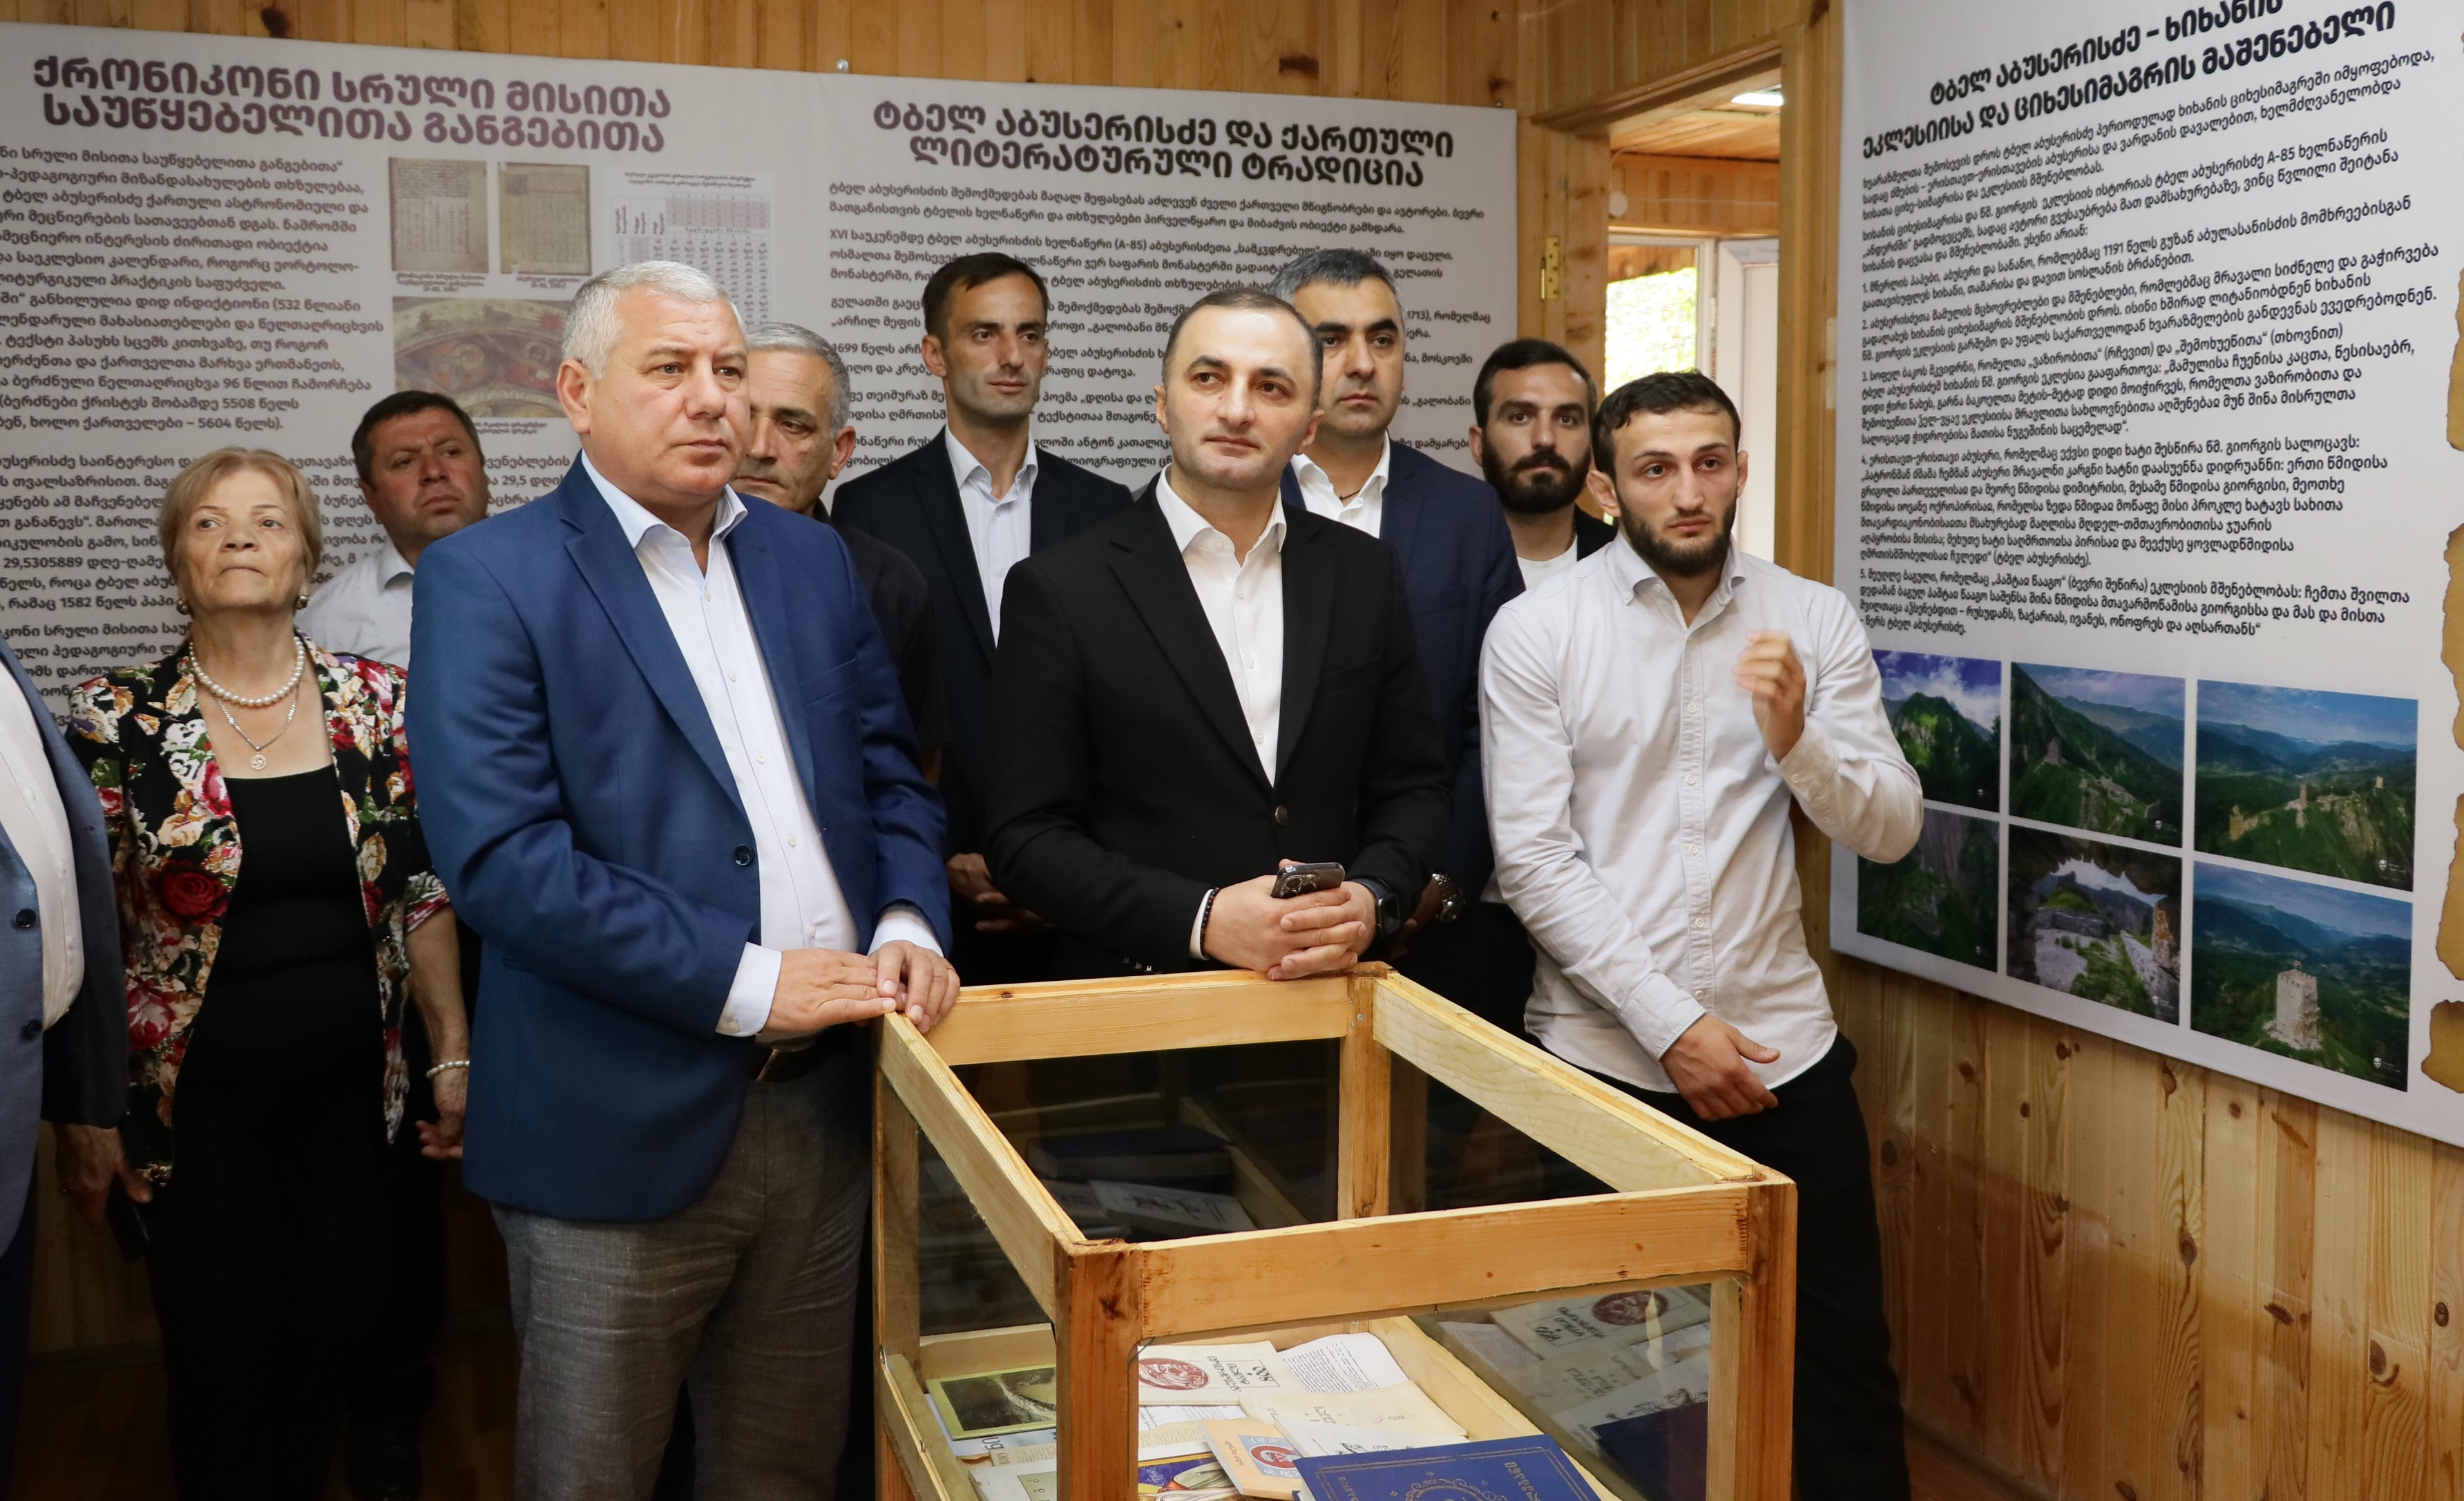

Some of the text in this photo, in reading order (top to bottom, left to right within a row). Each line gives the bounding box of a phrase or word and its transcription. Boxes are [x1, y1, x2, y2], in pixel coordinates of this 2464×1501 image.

[33, 55, 671, 119] ქრონიკონი სრული მისითა
[1863, 0, 2396, 159] ეკლესიისა და ციხესიმაგრის მაშენებელი
[1930, 68, 1992, 106] ტბელ
[1996, 25, 2141, 88] აბუსერისძე
[43, 93, 665, 152] საუწყებელითა განგებითა
[873, 101, 1453, 158] ტბელ აბუსერისძე და ქართული
[910, 135, 1424, 187] ლიტერატურული ტრადიცია
[2155, 170, 2189, 189] ტბელ
[2338, 256, 2358, 271] და
[2156, 344, 2172, 357] და
[2342, 367, 2362, 383] და
